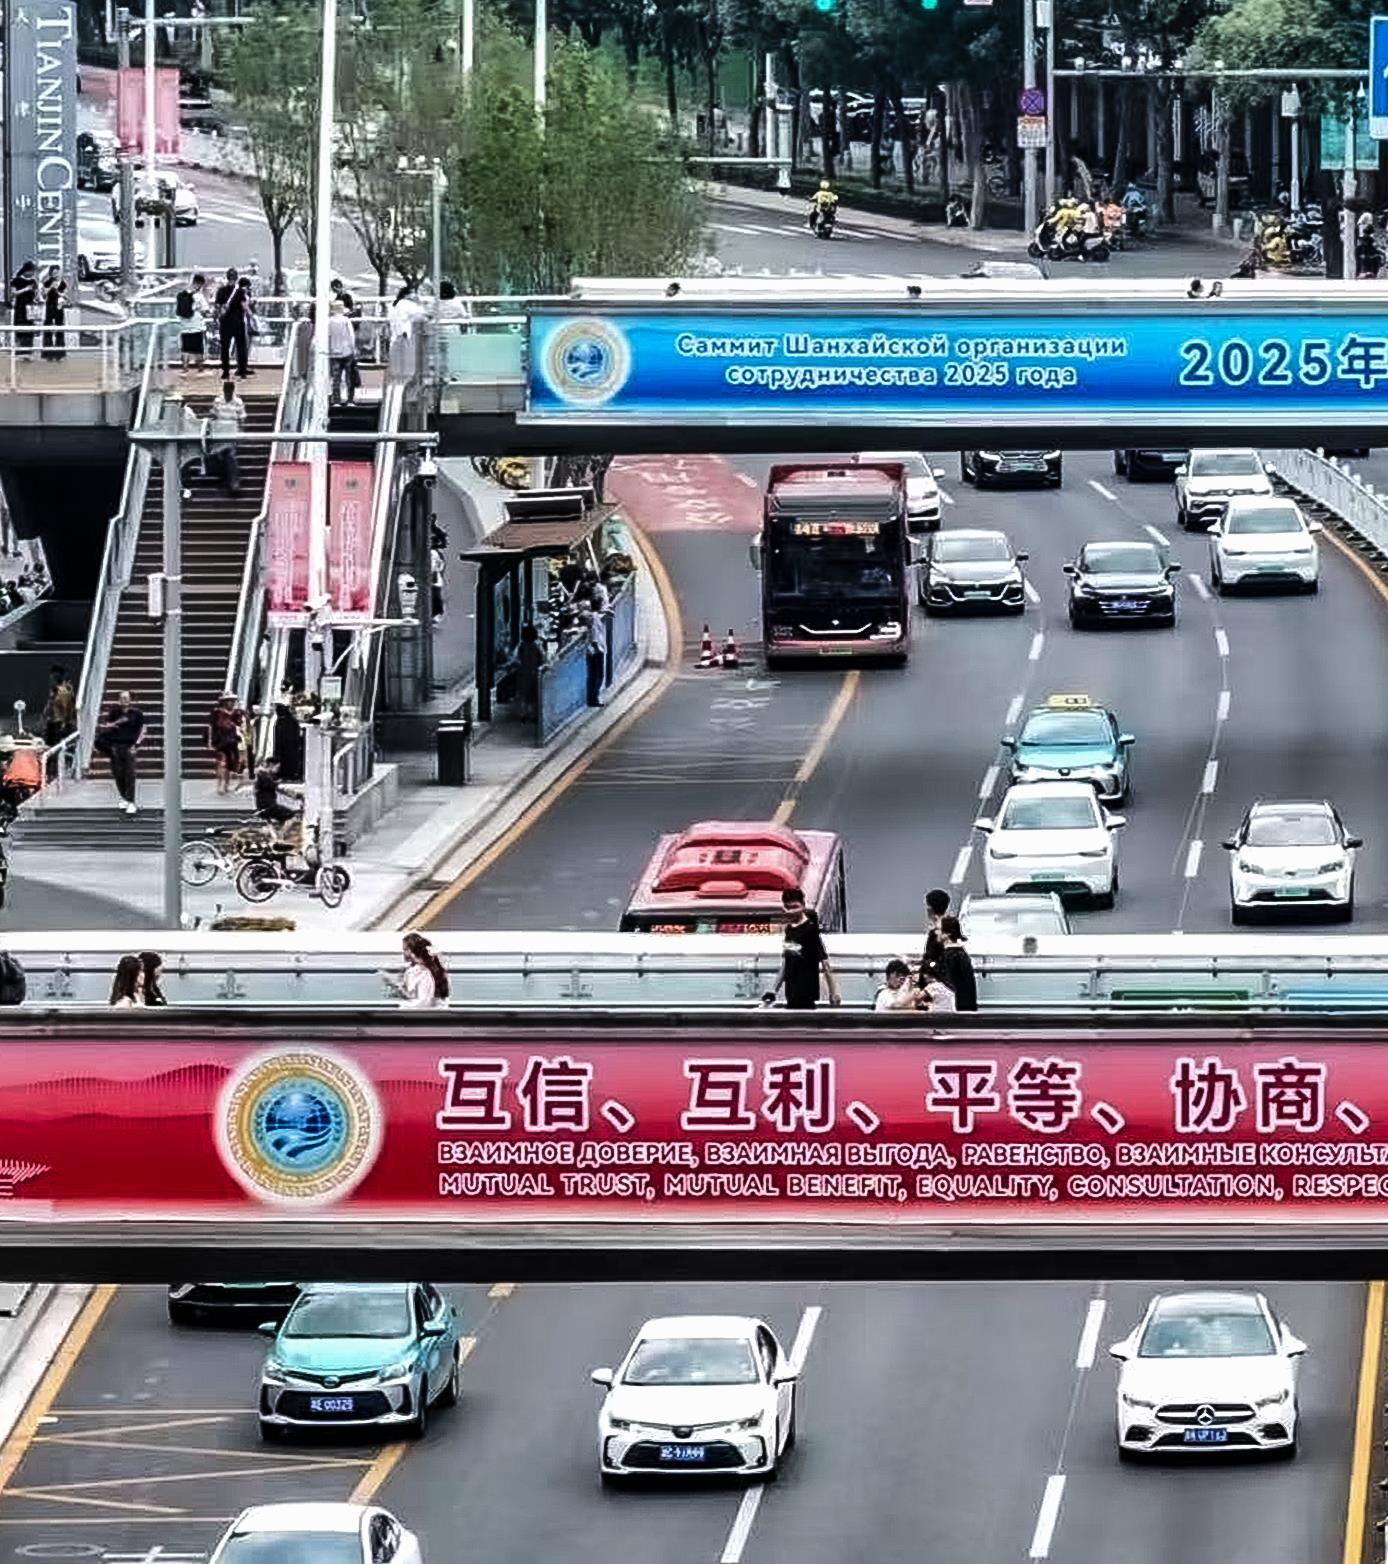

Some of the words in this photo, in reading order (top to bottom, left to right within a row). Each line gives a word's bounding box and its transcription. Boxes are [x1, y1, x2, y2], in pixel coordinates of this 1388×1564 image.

[677, 332, 775, 357] Саммит
[783, 331, 946, 358] Шанхайской
[956, 334, 1126, 360] организации
[725, 362, 936, 388] сотрудничества
[943, 360, 1008, 386] 2025
[1015, 363, 1077, 387] года
[439, 1142, 574, 1165] ВЗАИМНОЕ
[577, 1142, 699, 1169] ДОВЕРИЕ,
[705, 1142, 841, 1165] ВЗАИМНАЯ
[846, 1142, 957, 1169] ВЫГОДА,
[962, 1142, 1110, 1169] РАВЕНСТВО,
[1116, 1142, 1256, 1165] ВЗАИМНЫЕ
[439, 1174, 554, 1197] MUTUAL
[560, 1174, 656, 1200] TRUST,
[665, 1174, 779, 1197] MUTUAL
[787, 1174, 907, 1200] BENEFIT,
[916, 1174, 1059, 1200] EQUALITY,
[1068, 1174, 1284, 1200] CONSULTATION,
